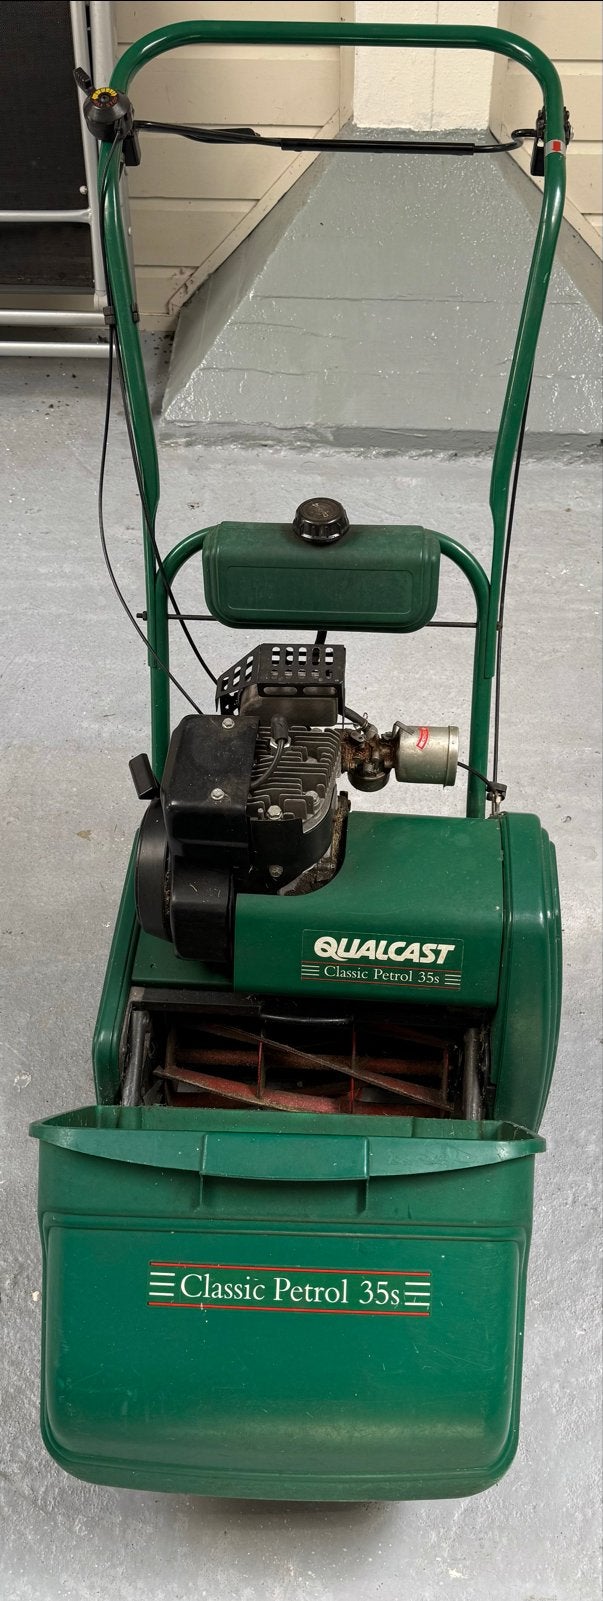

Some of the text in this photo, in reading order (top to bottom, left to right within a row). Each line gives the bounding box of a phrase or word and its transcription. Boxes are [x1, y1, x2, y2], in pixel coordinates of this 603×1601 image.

[314, 936, 456, 964] QUALCAST
[324, 965, 440, 984] Classic Petrol 35s
[180, 1273, 400, 1306] Classic Petrol 35s
